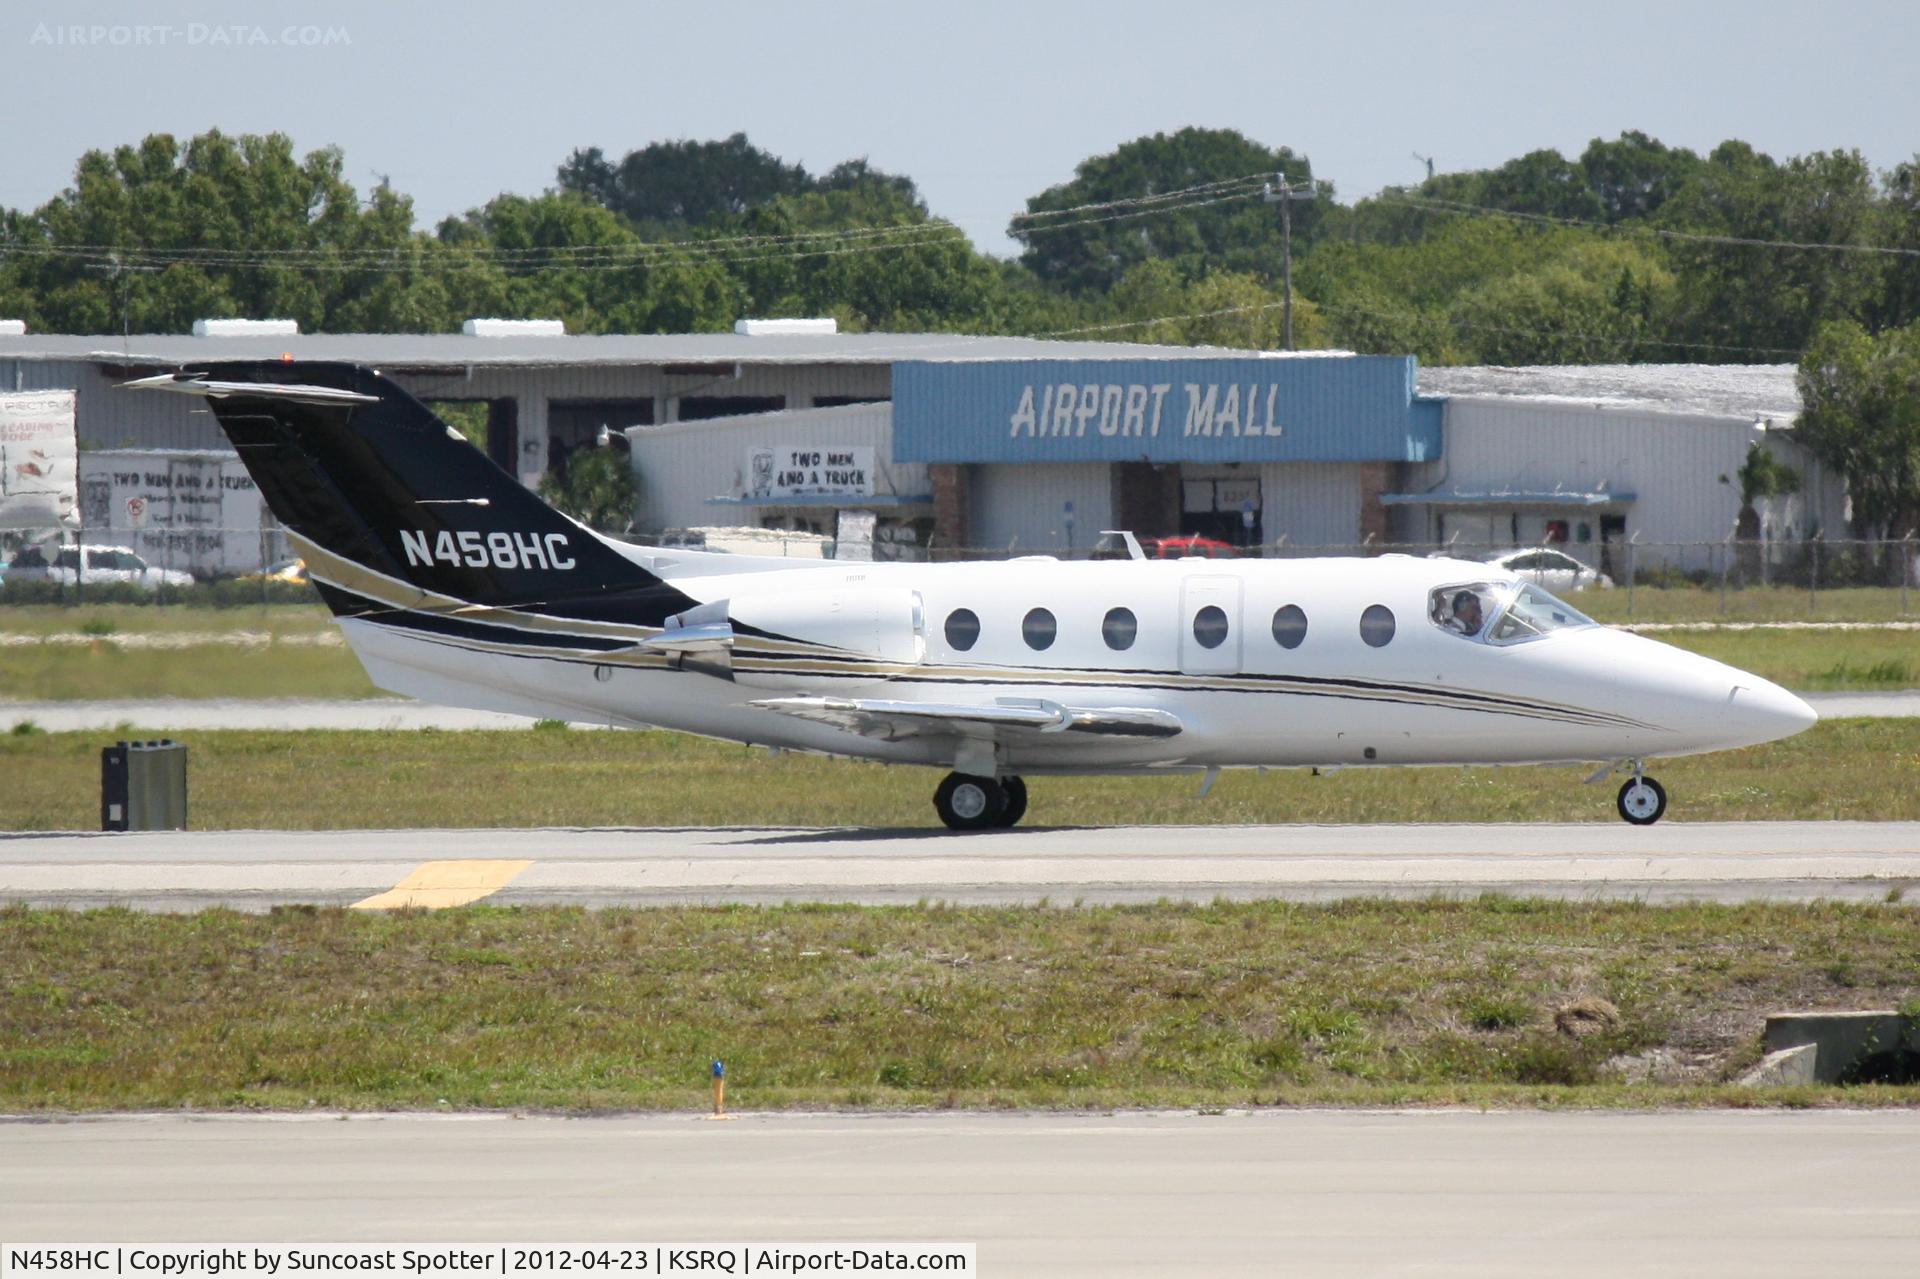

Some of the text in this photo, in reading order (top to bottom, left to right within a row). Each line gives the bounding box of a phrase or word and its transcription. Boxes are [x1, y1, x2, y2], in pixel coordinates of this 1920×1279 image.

[1010, 383, 1282, 438] AIRPORT MALL
[791, 451, 854, 467] TWO MEN
[113, 472, 140, 488] TWO
[175, 473, 201, 489] AND
[205, 475, 214, 489] A
[777, 469, 865, 487] AND A TRUCK
[400, 529, 576, 570] N458HC
